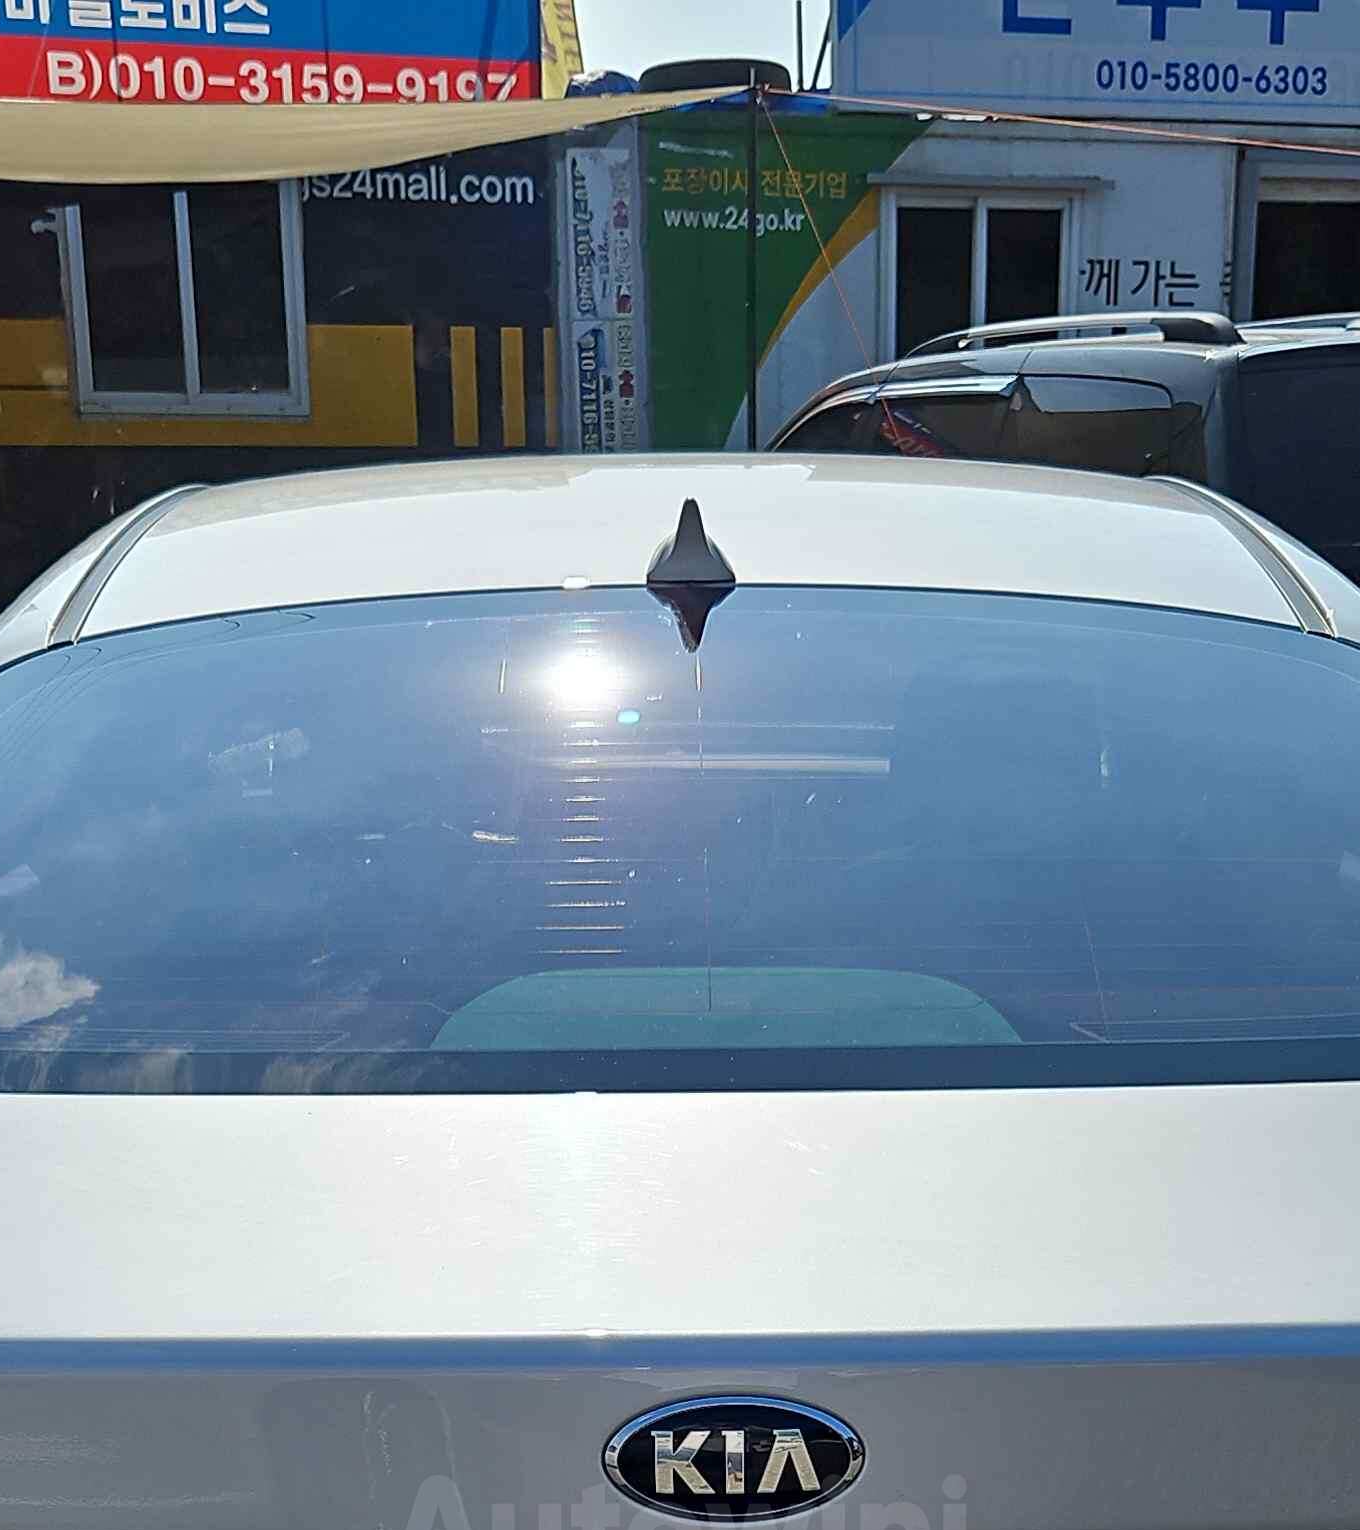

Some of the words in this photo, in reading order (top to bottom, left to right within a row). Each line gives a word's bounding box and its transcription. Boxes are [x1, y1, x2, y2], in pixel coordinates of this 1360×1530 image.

[1095, 58, 1328, 96] 010-5800-6303
[663, 205, 806, 237] www.24go.kr
[1080, 258, 1121, 306] 께
[1130, 259, 1200, 307] 가는
[652, 1427, 822, 1495] KIA
